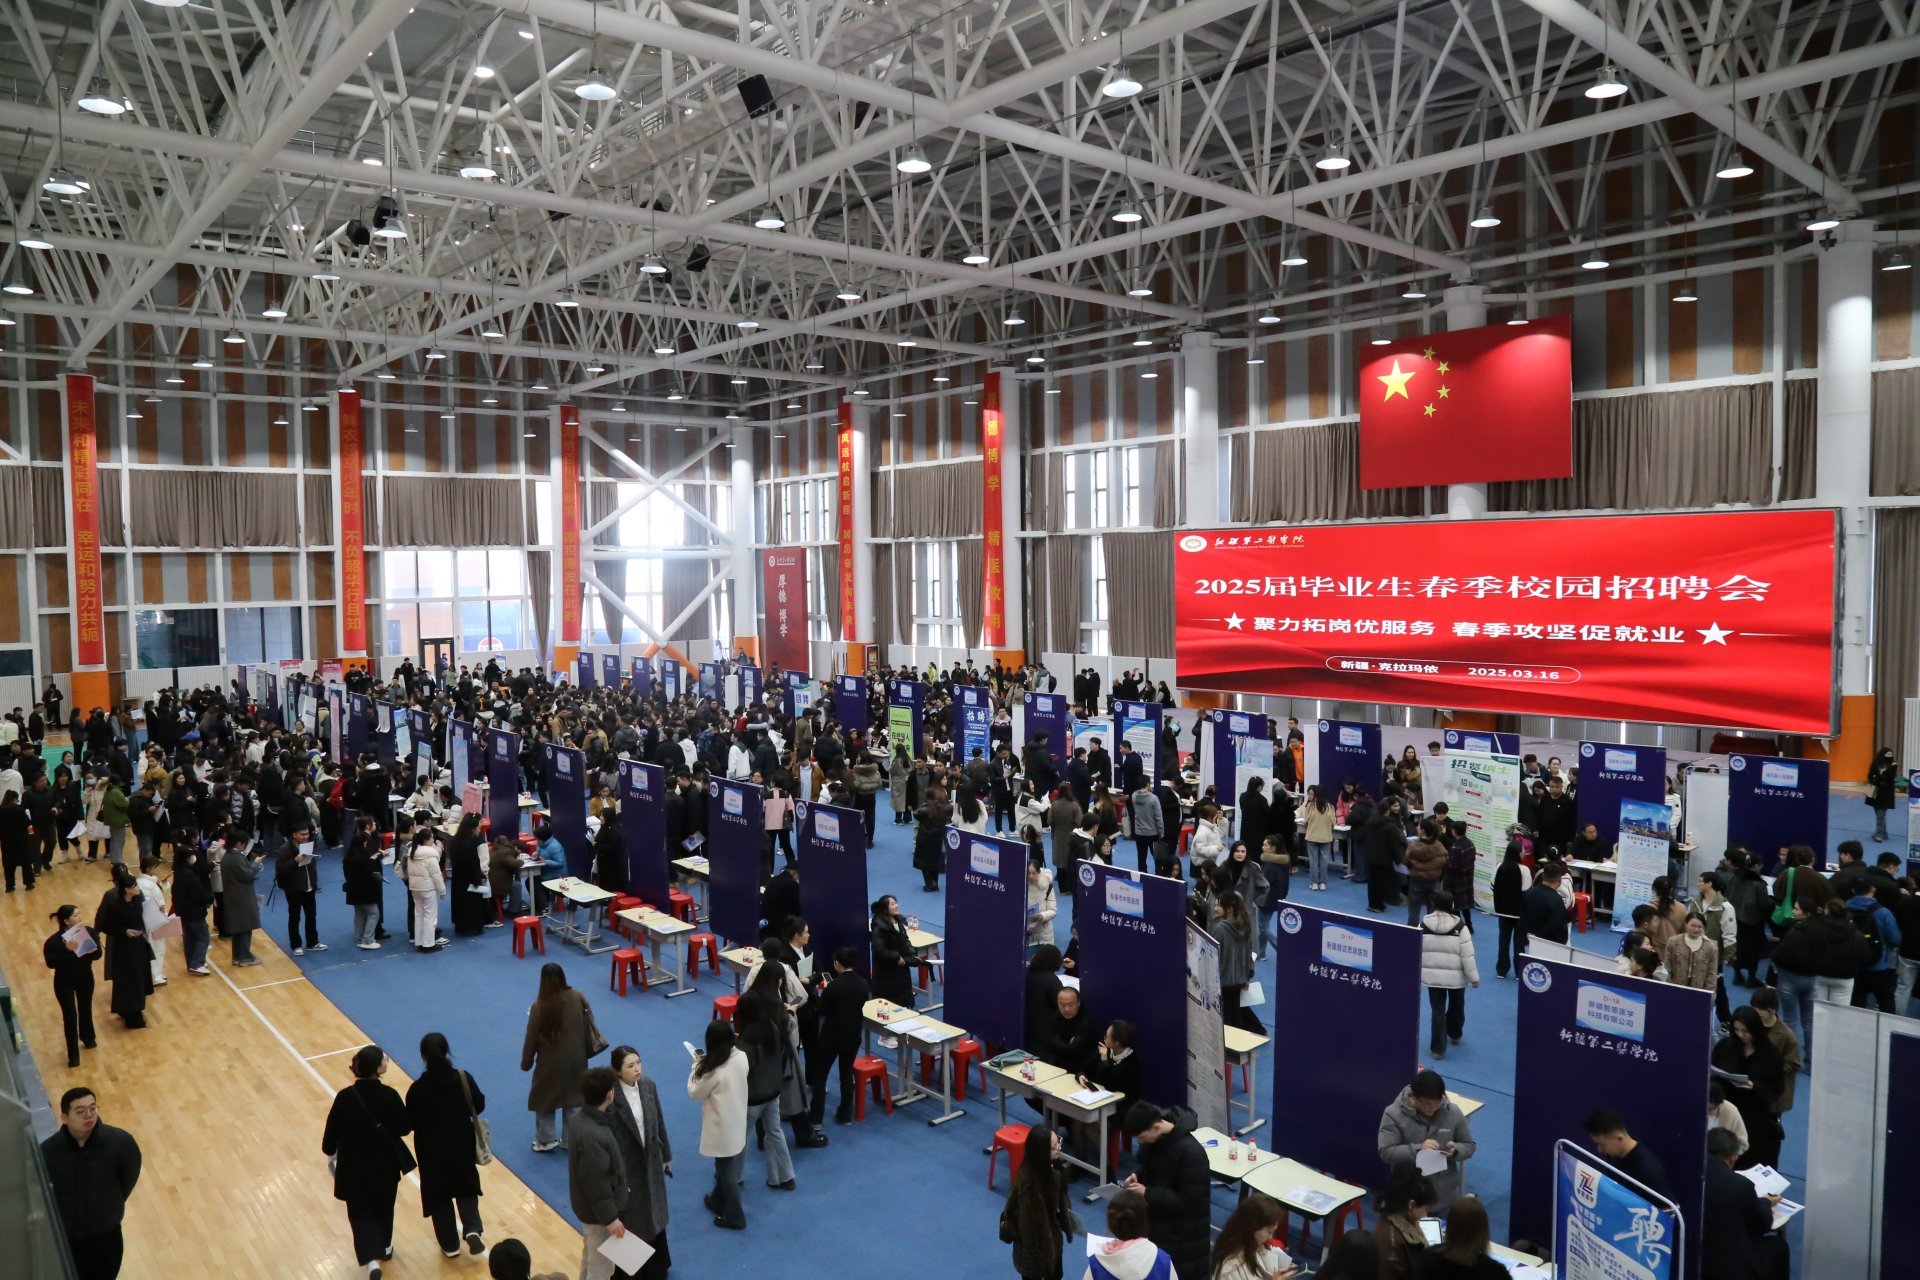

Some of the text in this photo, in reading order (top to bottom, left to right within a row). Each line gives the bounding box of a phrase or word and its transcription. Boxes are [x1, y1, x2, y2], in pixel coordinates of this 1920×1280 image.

[71, 399, 99, 642] 未来和精彩同在 幸运和努力共轭
[345, 529, 361, 631] 不负韶华行且知
[1194, 574, 1772, 602] 2025届毕业生春季校园招聘会
[1253, 616, 1685, 643] 聚力拓岗优服务 春季攻坚促就业
[1340, 660, 1560, 680] 新疆·克拉玛依 2025.03.16
[796, 694, 809, 704] 招聘
[966, 709, 986, 723] 招聘
[1451, 759, 1511, 774] 招贤纳士
[1587, 1010, 1634, 1028] 科技有限公司
[1613, 1205, 1672, 1270] 聘
